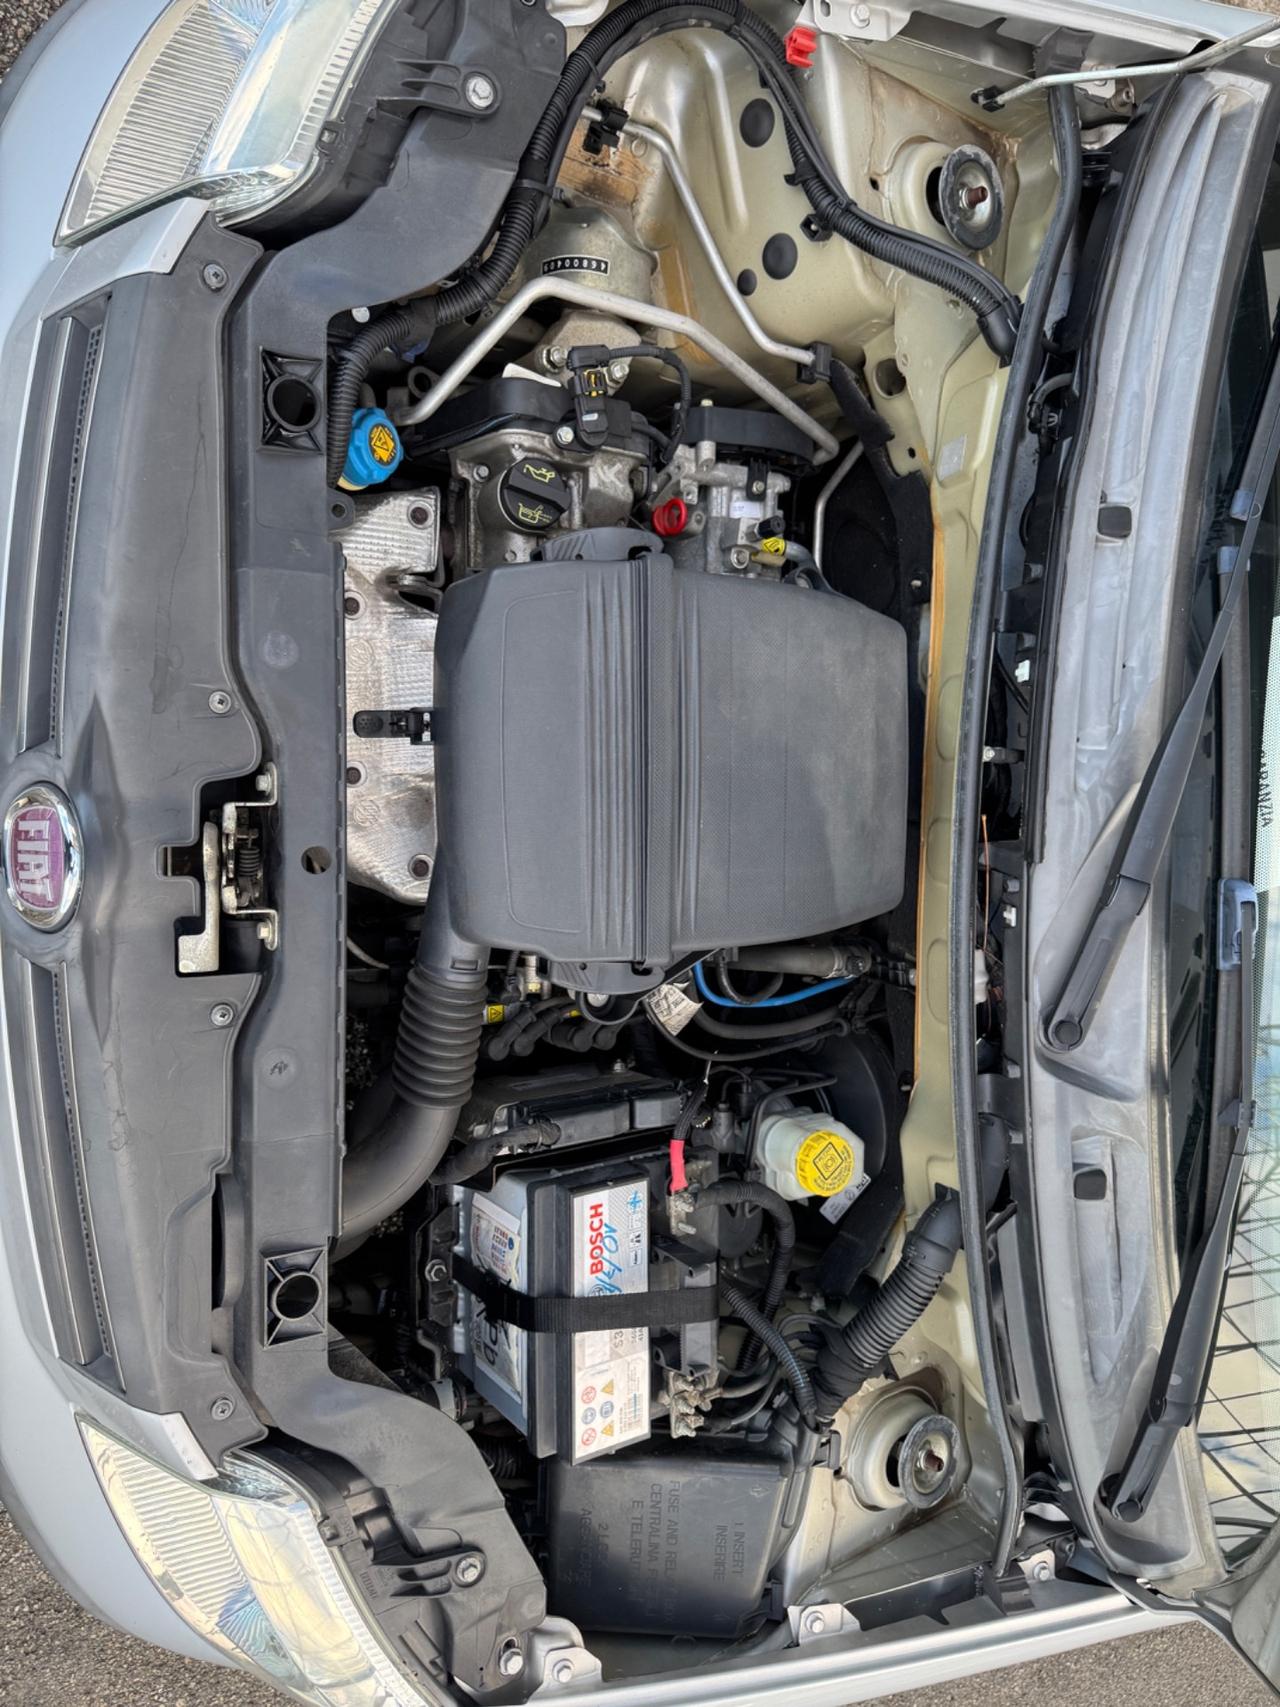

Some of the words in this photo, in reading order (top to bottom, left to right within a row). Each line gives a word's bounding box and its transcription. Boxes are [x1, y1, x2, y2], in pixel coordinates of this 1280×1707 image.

[17, 819, 54, 902] FIAT
[590, 1203, 604, 1275] BOSCH
[648, 1483, 663, 1562] CENTRALINA
[667, 1480, 680, 1513] FUSE
[666, 1519, 679, 1546] AND
[713, 1525, 728, 1582] INSERIRE
[732, 1531, 745, 1576] INSERT
